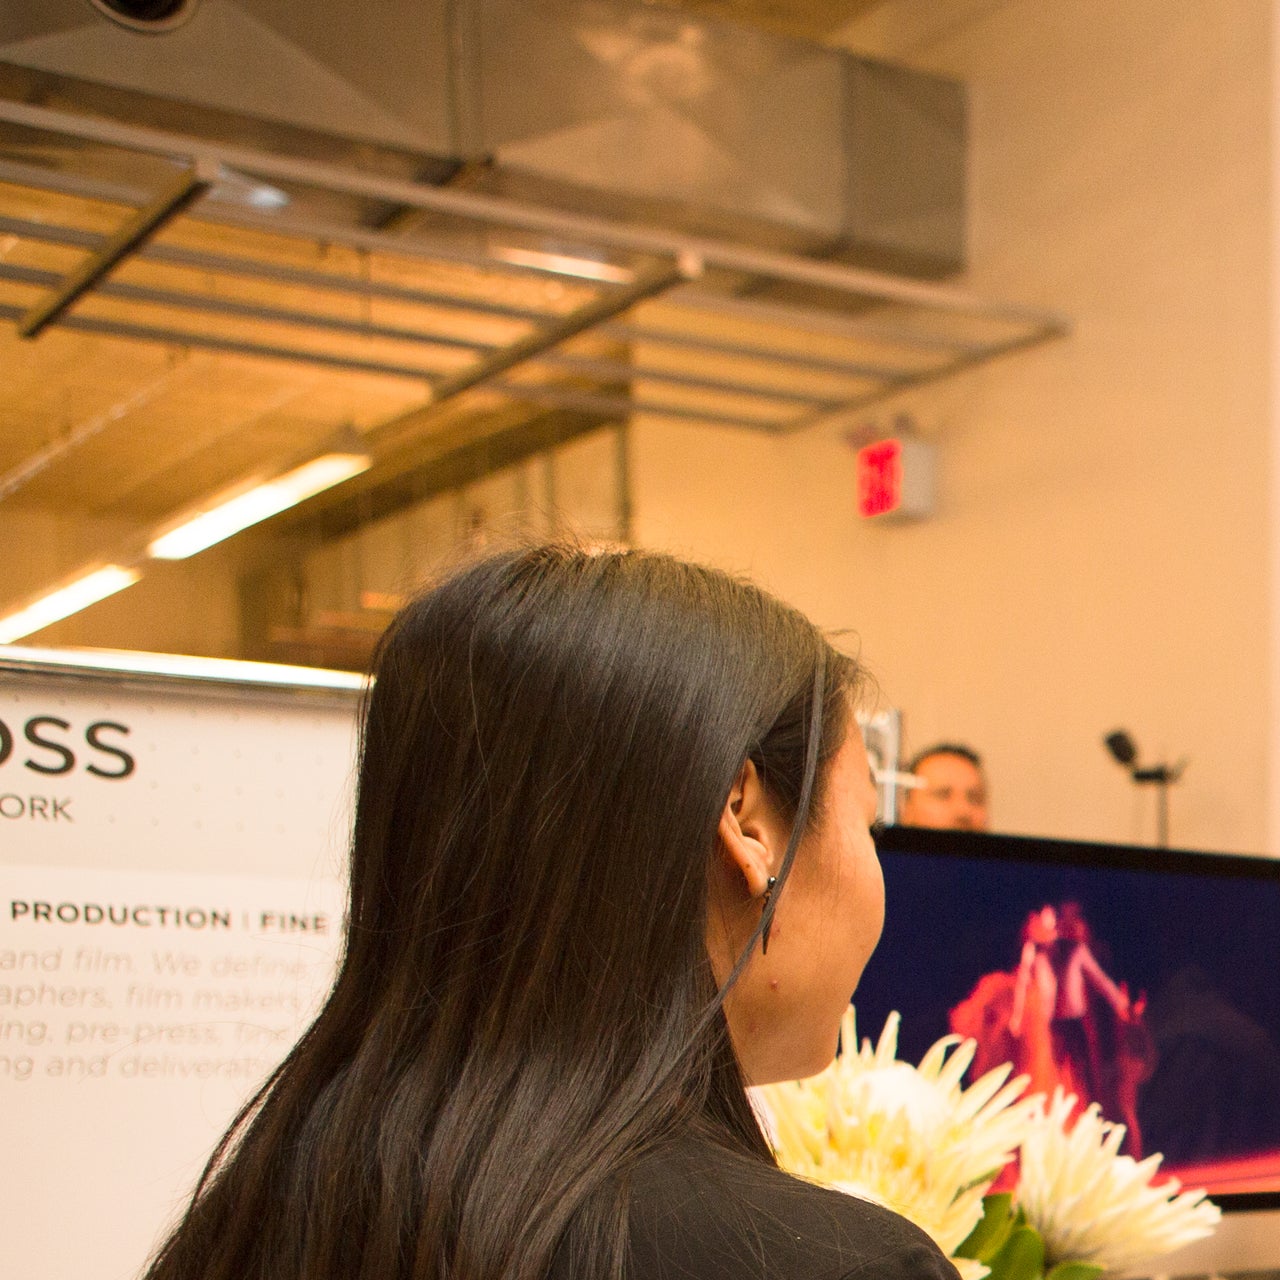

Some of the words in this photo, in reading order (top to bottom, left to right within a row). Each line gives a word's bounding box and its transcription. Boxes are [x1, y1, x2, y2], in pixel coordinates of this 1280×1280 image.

[0, 714, 136, 780] SS
[11, 899, 231, 929] PRODUCTION
[260, 910, 330, 935] FINE
[152, 947, 200, 976] We
